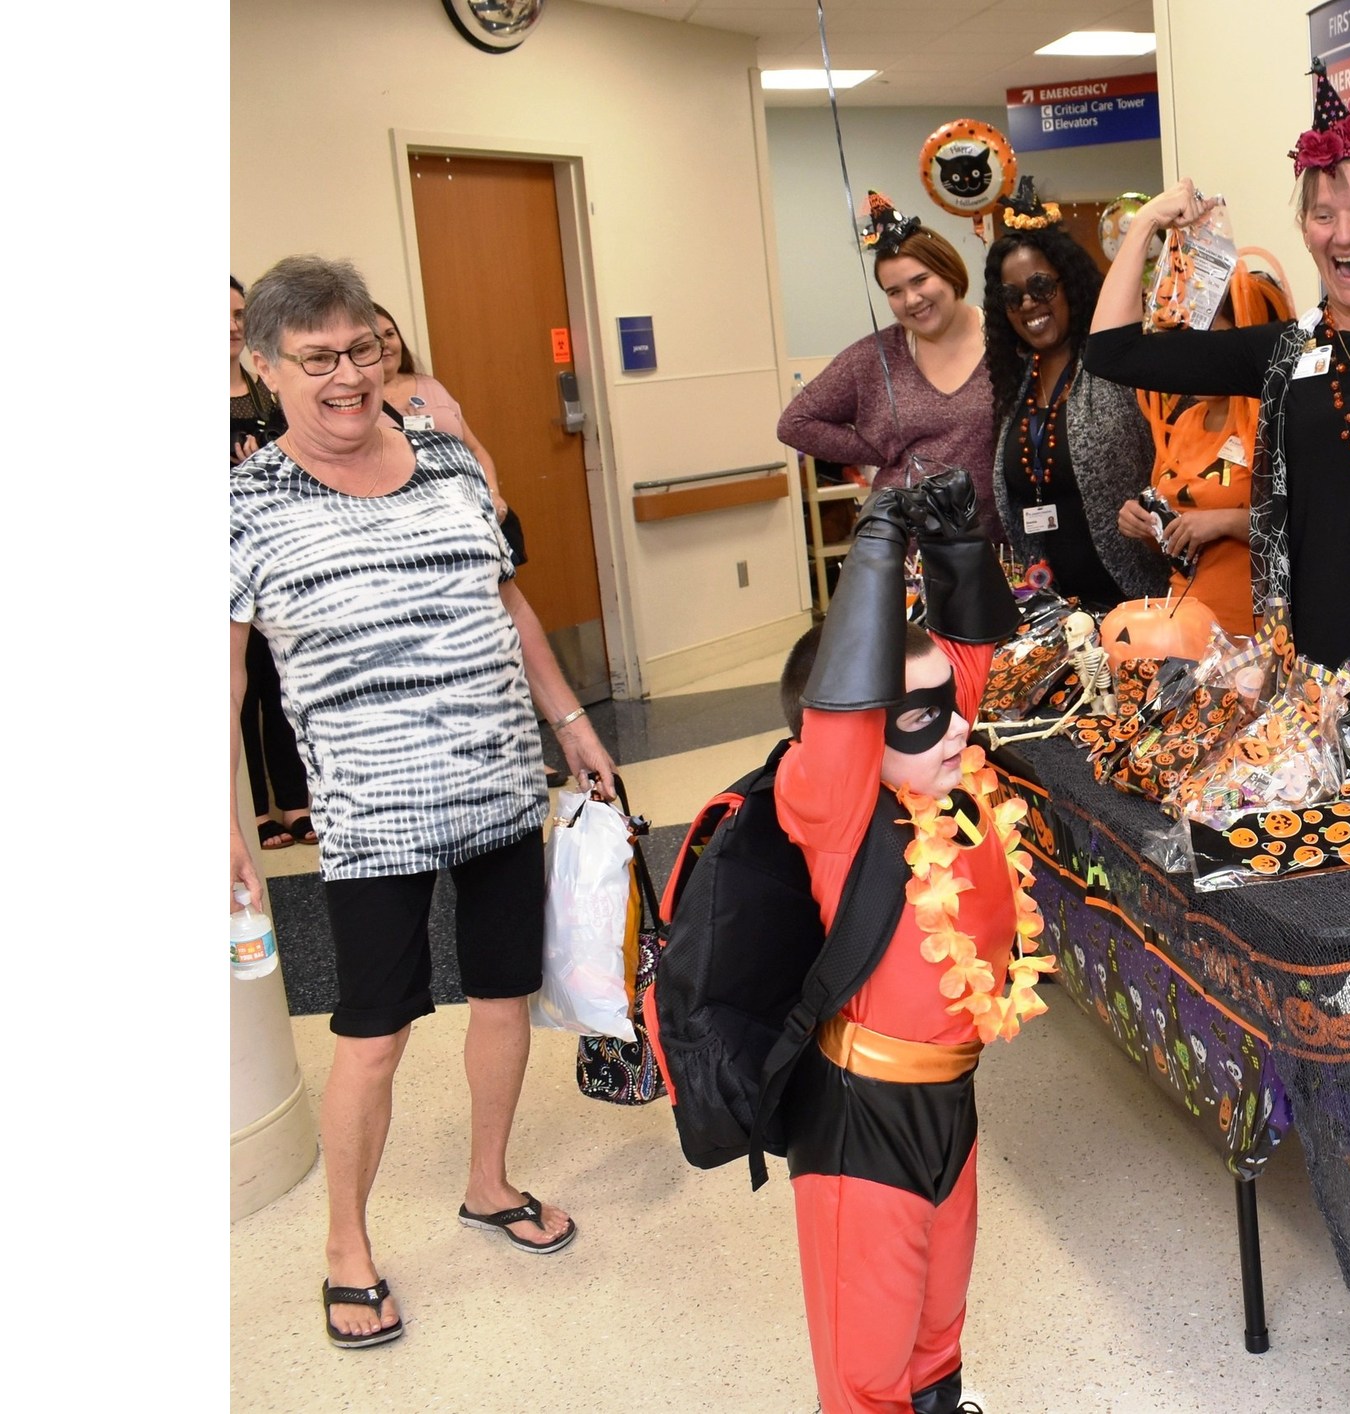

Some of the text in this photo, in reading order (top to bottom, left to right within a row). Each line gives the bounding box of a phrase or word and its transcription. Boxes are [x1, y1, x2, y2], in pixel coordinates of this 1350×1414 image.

[1040, 82, 1108, 101] EMERGENCY
[1055, 102, 1088, 116] Critical
[1091, 100, 1113, 113] Care
[1116, 98, 1145, 109] Tower
[1055, 116, 1098, 130] Elevators
